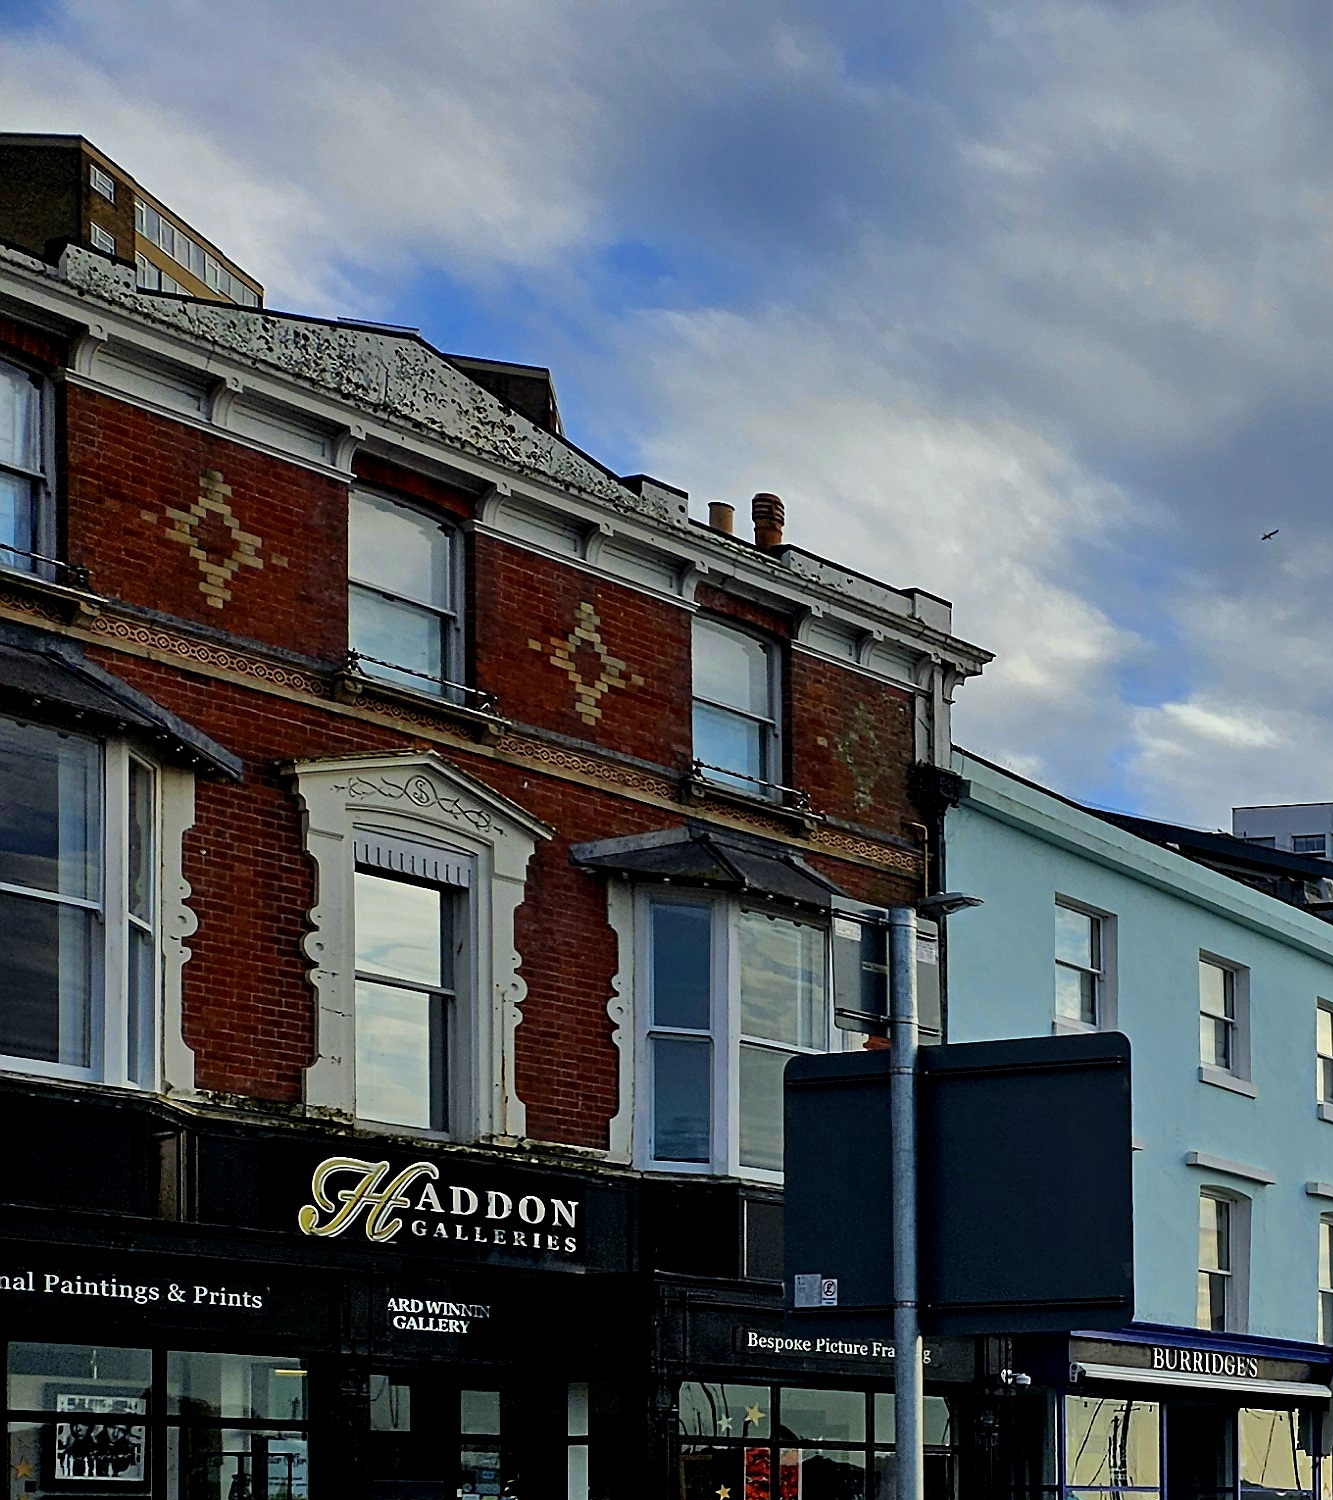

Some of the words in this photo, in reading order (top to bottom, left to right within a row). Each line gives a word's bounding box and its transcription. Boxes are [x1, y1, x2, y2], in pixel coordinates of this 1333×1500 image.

[299, 1157, 579, 1242] HADDON
[411, 1220, 577, 1252] GALLERIES
[44, 1274, 160, 1304] Paintings
[167, 1284, 186, 1302] &
[193, 1286, 263, 1308] Prints
[393, 1316, 471, 1334] GALLERY
[747, 1332, 811, 1353] Bespoke
[816, 1338, 868, 1356] Picture
[872, 1342, 931, 1364] Frag
[1153, 1347, 1258, 1378] BURRIDGE'S
